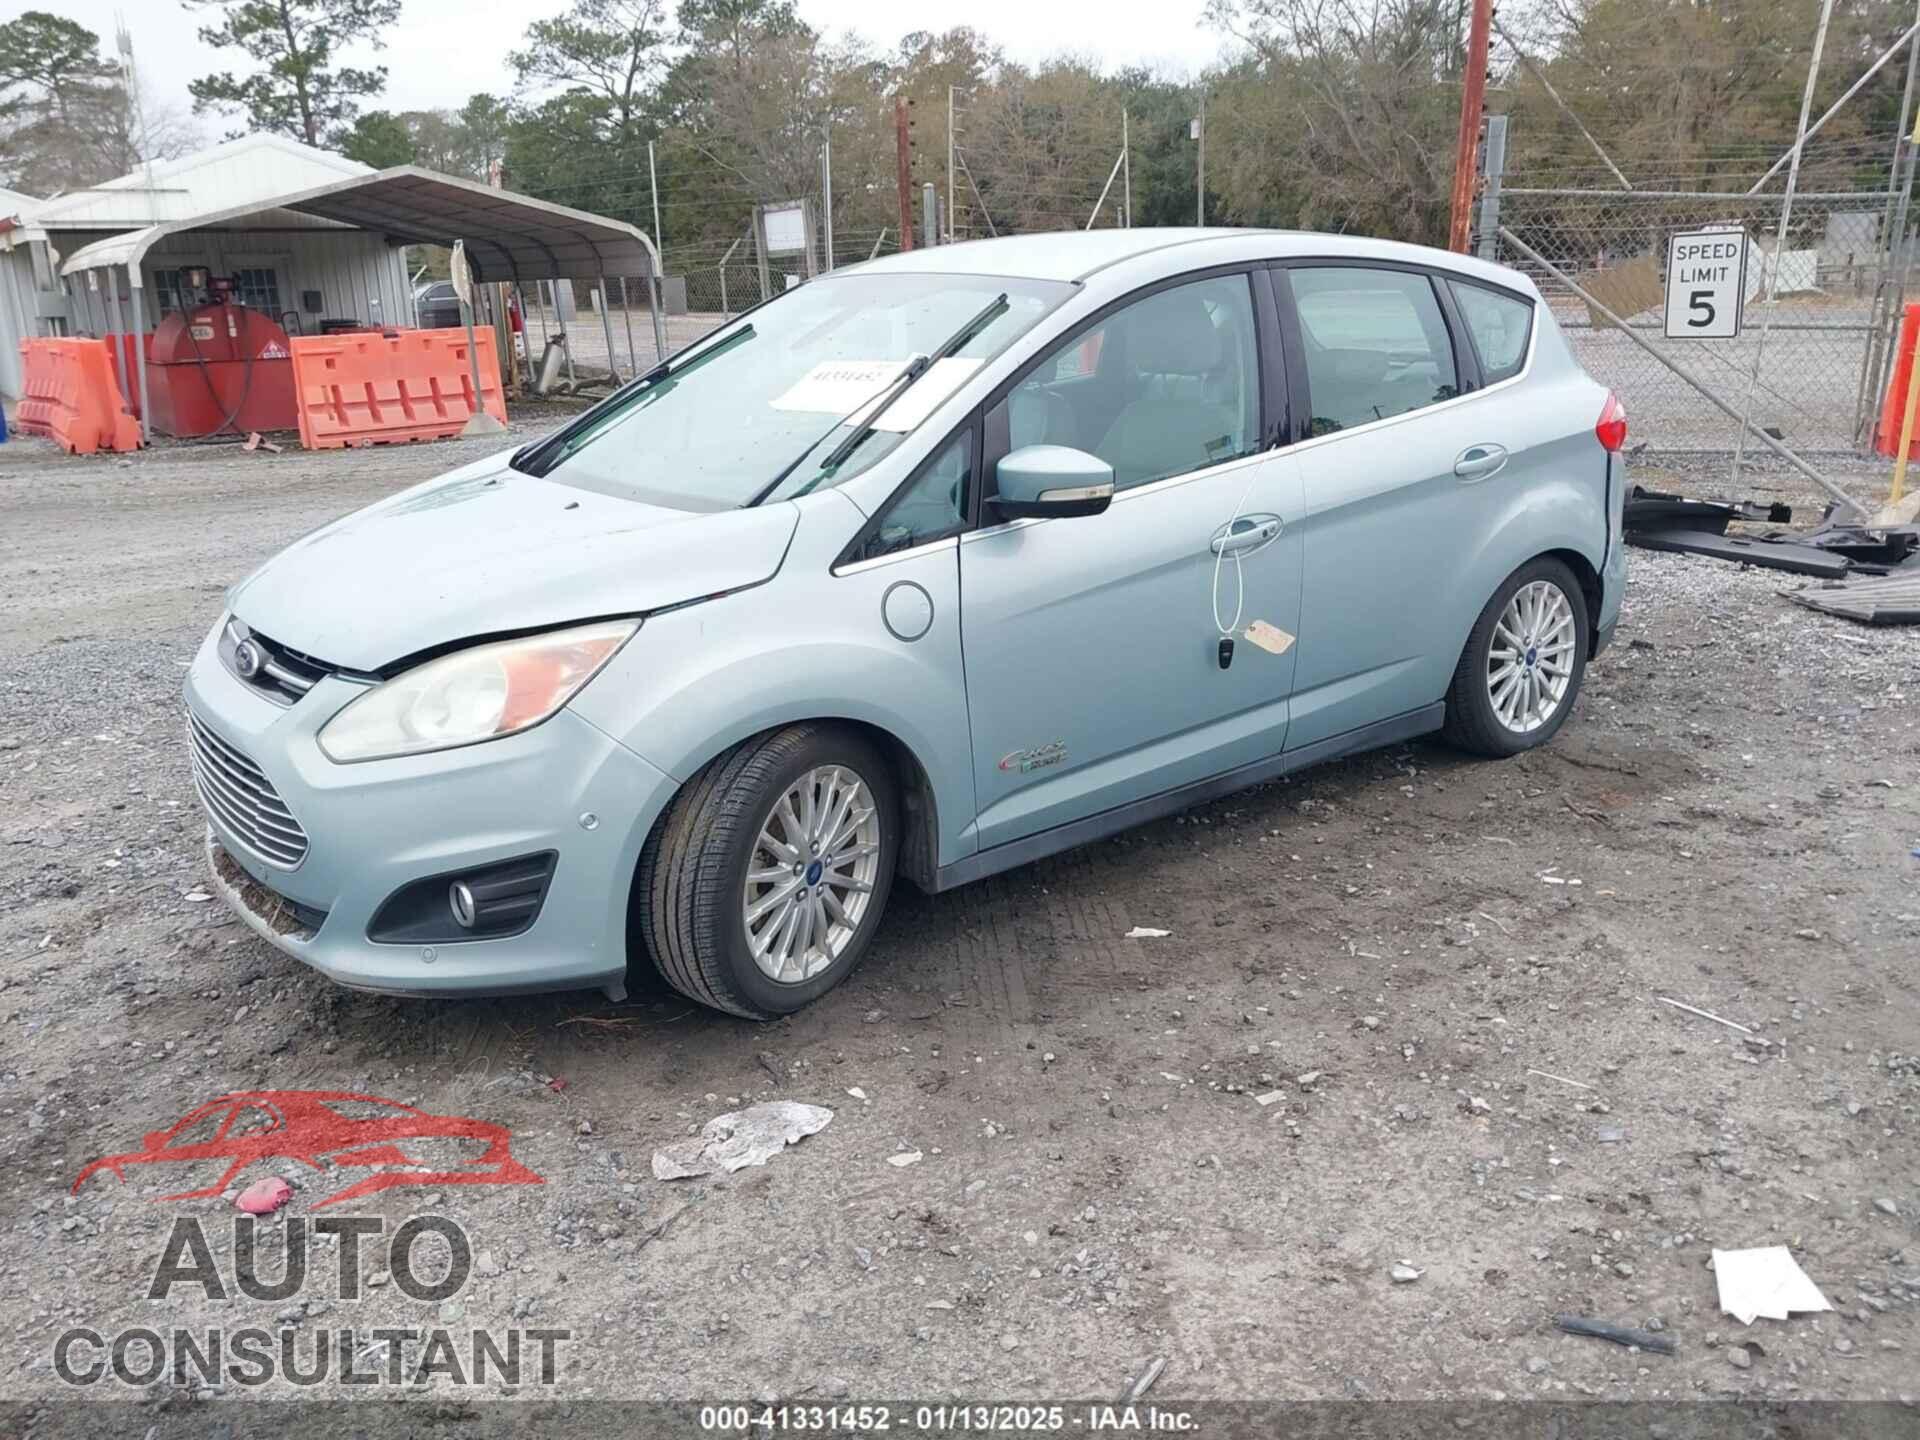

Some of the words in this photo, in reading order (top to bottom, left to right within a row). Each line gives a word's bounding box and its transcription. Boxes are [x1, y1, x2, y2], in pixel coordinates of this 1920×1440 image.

[1676, 243, 1737, 261] SPEED
[1680, 266, 1729, 283] LIMIT
[1687, 290, 1716, 328] 5
